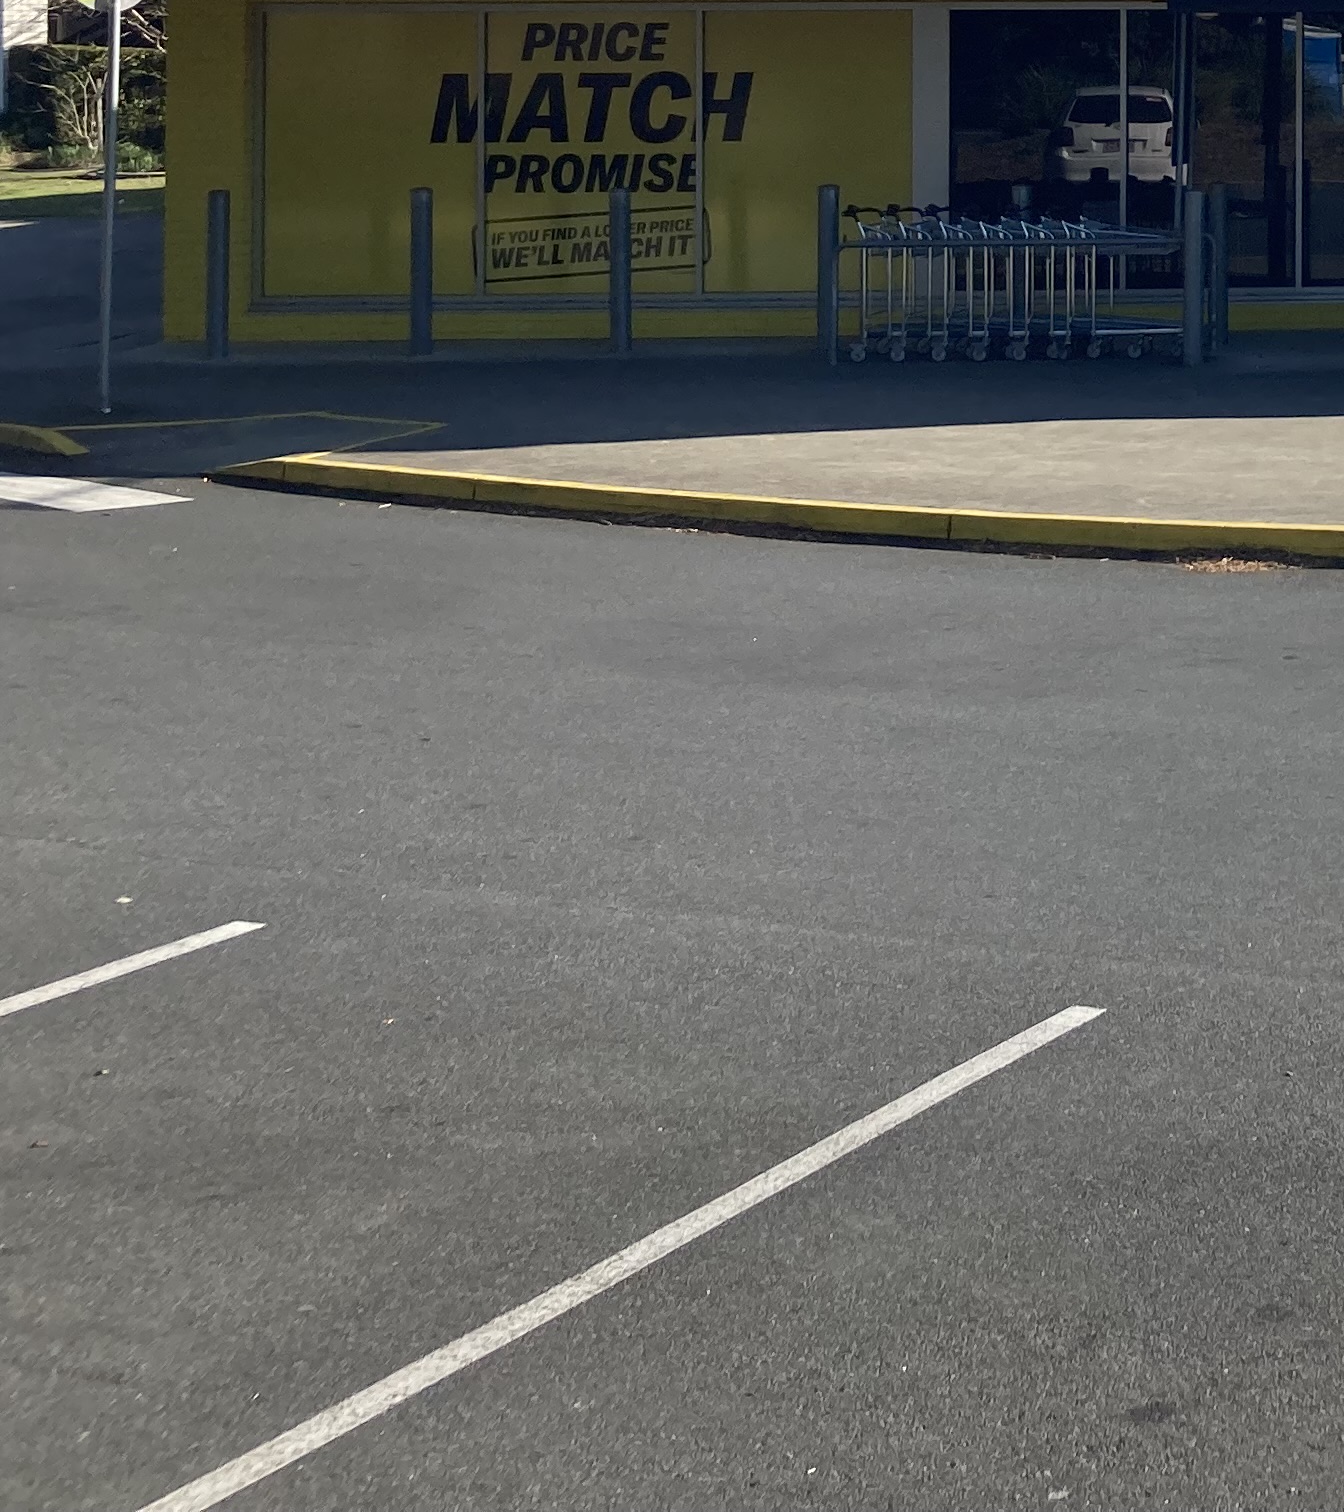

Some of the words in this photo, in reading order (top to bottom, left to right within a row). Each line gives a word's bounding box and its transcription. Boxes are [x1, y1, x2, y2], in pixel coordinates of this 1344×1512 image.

[521, 22, 669, 61] PRICE
[430, 70, 754, 144] MATCH
[485, 153, 696, 193] PROMISE
[491, 232, 505, 246] IF
[508, 230, 539, 245] YOU
[543, 226, 577, 242] FIND
[580, 225, 592, 238] A
[594, 220, 646, 238] LOER
[649, 218, 696, 234] PRICE
[491, 244, 565, 269] WE'LL
[570, 237, 662, 264] MACH
[668, 234, 694, 257] IT
